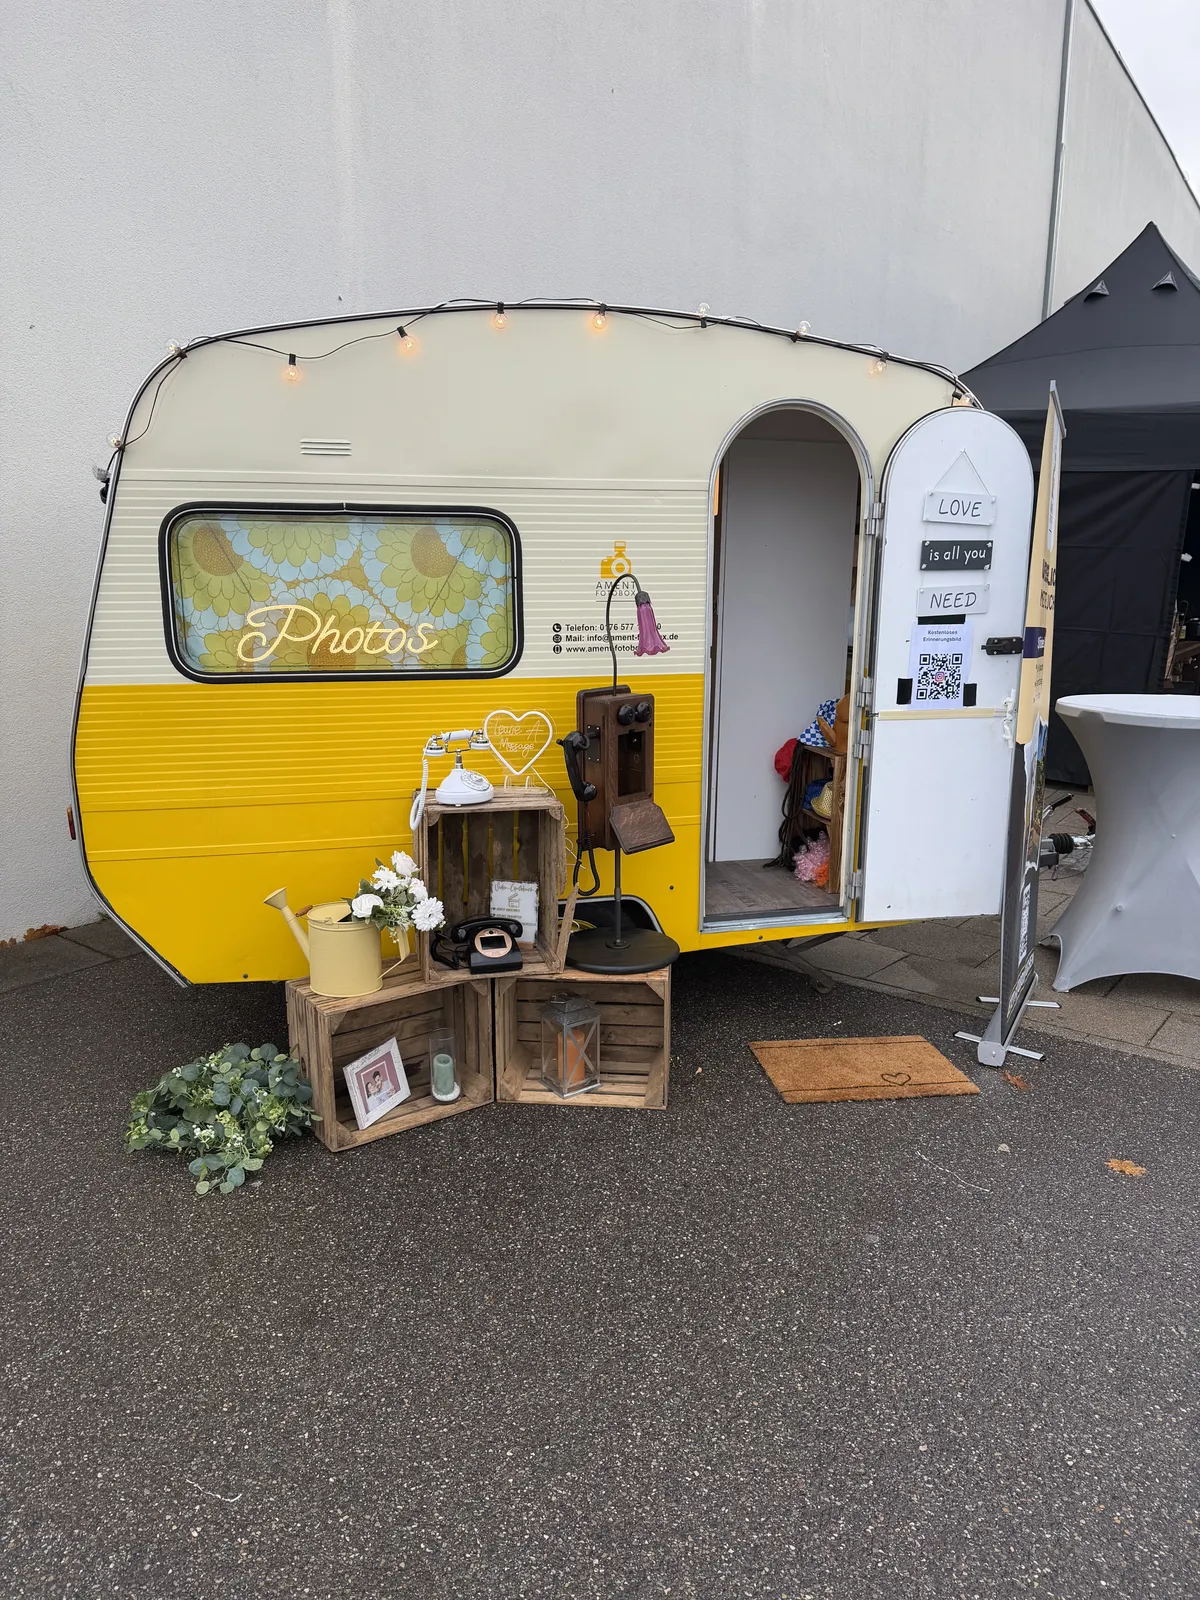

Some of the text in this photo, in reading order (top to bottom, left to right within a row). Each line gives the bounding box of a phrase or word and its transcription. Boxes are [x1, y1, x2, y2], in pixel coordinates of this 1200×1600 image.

[938, 499, 982, 518] LOVE
[929, 545, 986, 565] is all you
[595, 581, 636, 590] AMENT
[930, 592, 977, 609] NEED
[237, 604, 439, 662] Photos
[565, 623, 598, 632] Telefon:
[599, 623, 619, 631] 076
[620, 623, 635, 631] 577
[565, 632, 679, 643] Mail: info@ment-fx.de
[494, 716, 544, 744] Leave A
[500, 738, 535, 758] Message
